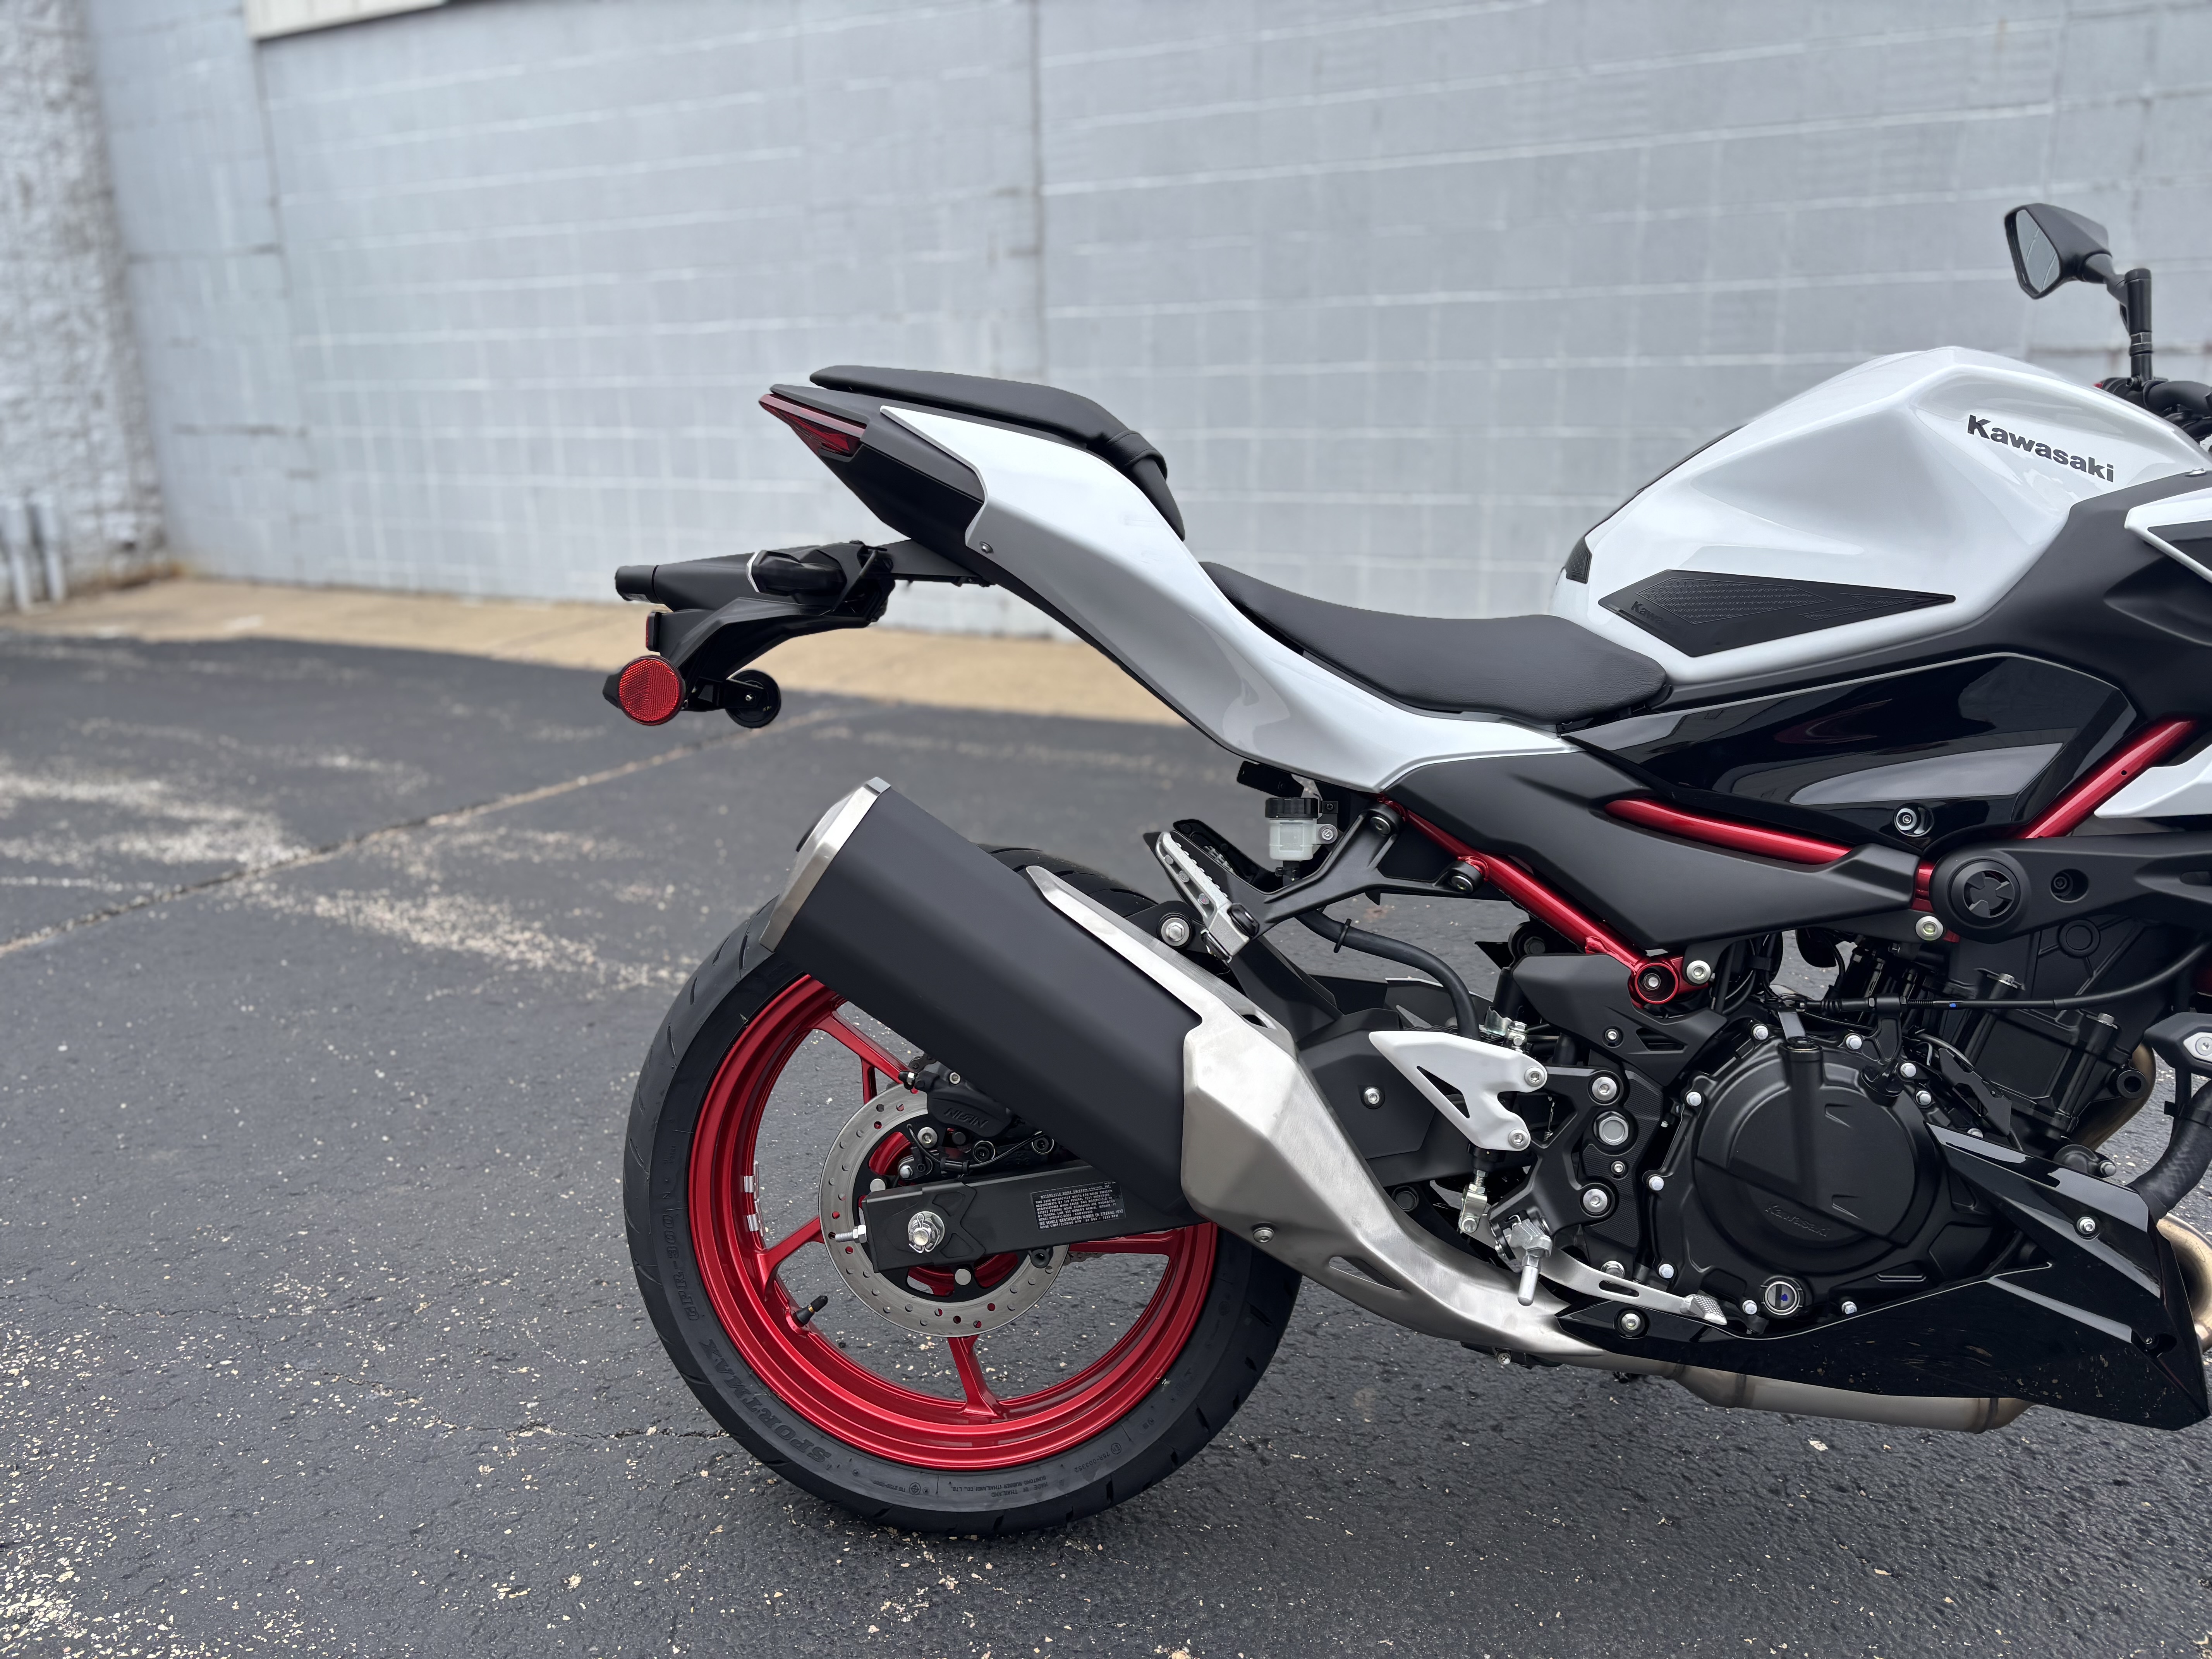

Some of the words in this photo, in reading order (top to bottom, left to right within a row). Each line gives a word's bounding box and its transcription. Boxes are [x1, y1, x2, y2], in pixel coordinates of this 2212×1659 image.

[1967, 414, 2114, 482] Kawasaki
[662, 1214, 699, 1321] GPR-300
[699, 1339, 832, 1463] SPORTMAX
